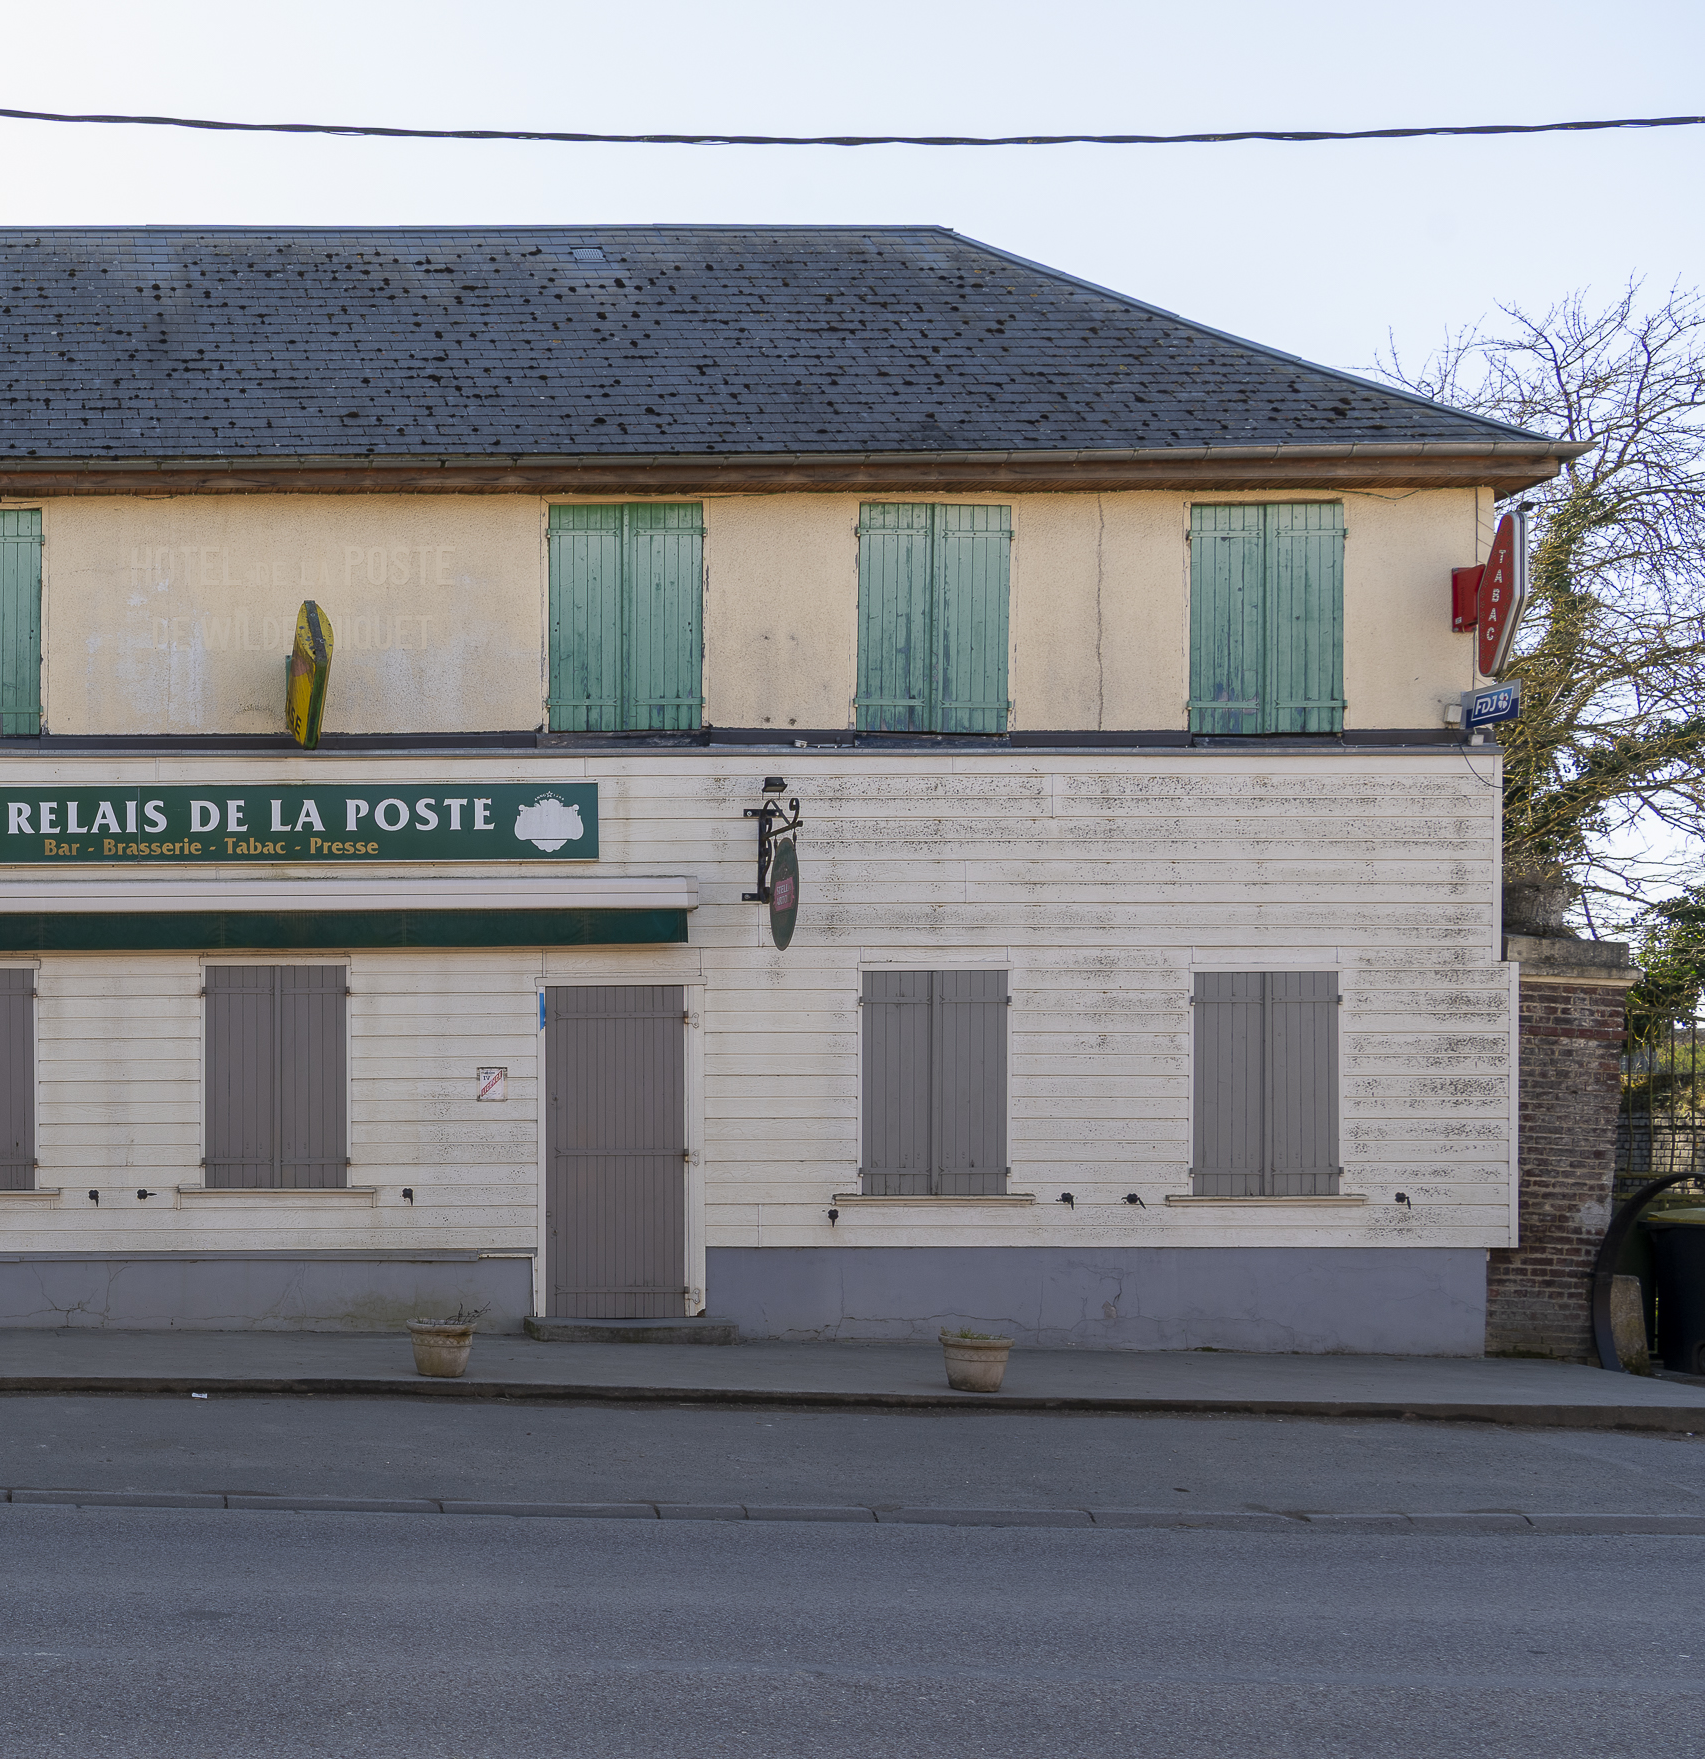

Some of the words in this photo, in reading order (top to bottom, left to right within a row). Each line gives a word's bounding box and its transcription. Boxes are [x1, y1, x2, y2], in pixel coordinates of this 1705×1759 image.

[344, 545, 456, 586] POSTE
[1486, 549, 1506, 641] TABAC
[1475, 694, 1497, 715] FDJ
[7, 800, 168, 835] RELAIS
[189, 800, 249, 833] DE
[269, 799, 326, 832] LA
[345, 797, 496, 832] POSTE
[44, 839, 78, 856] Bar
[103, 837, 203, 856] Brasserie
[224, 837, 287, 855] Tabac
[310, 837, 379, 855] Presse
